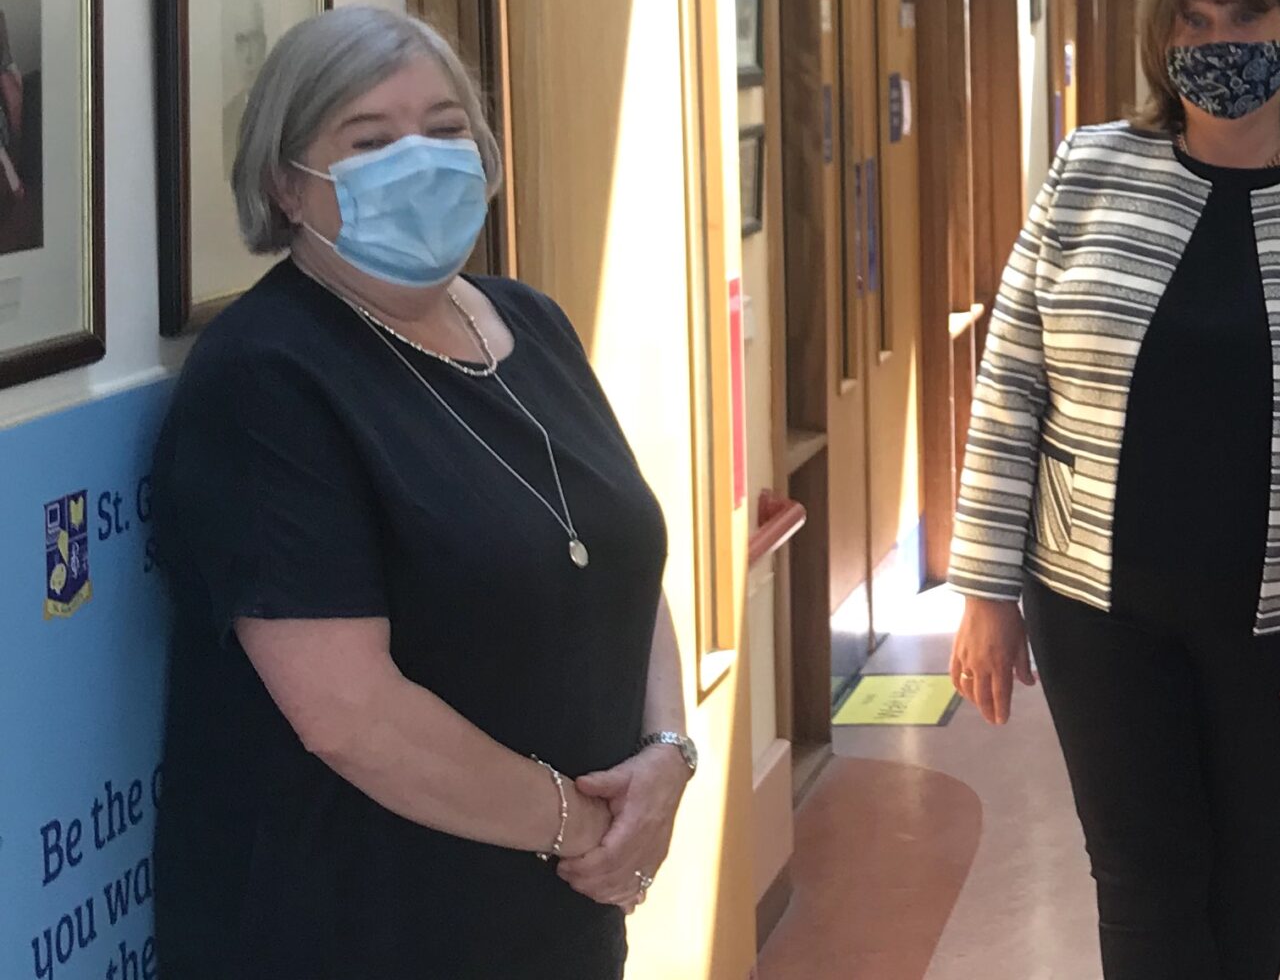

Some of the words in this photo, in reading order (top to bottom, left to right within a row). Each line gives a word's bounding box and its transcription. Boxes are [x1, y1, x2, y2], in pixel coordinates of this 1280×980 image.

[98, 491, 130, 541] St.
[40, 819, 83, 886] Be
[91, 779, 143, 850] the
[31, 897, 97, 980] you
[104, 858, 153, 926] wa
